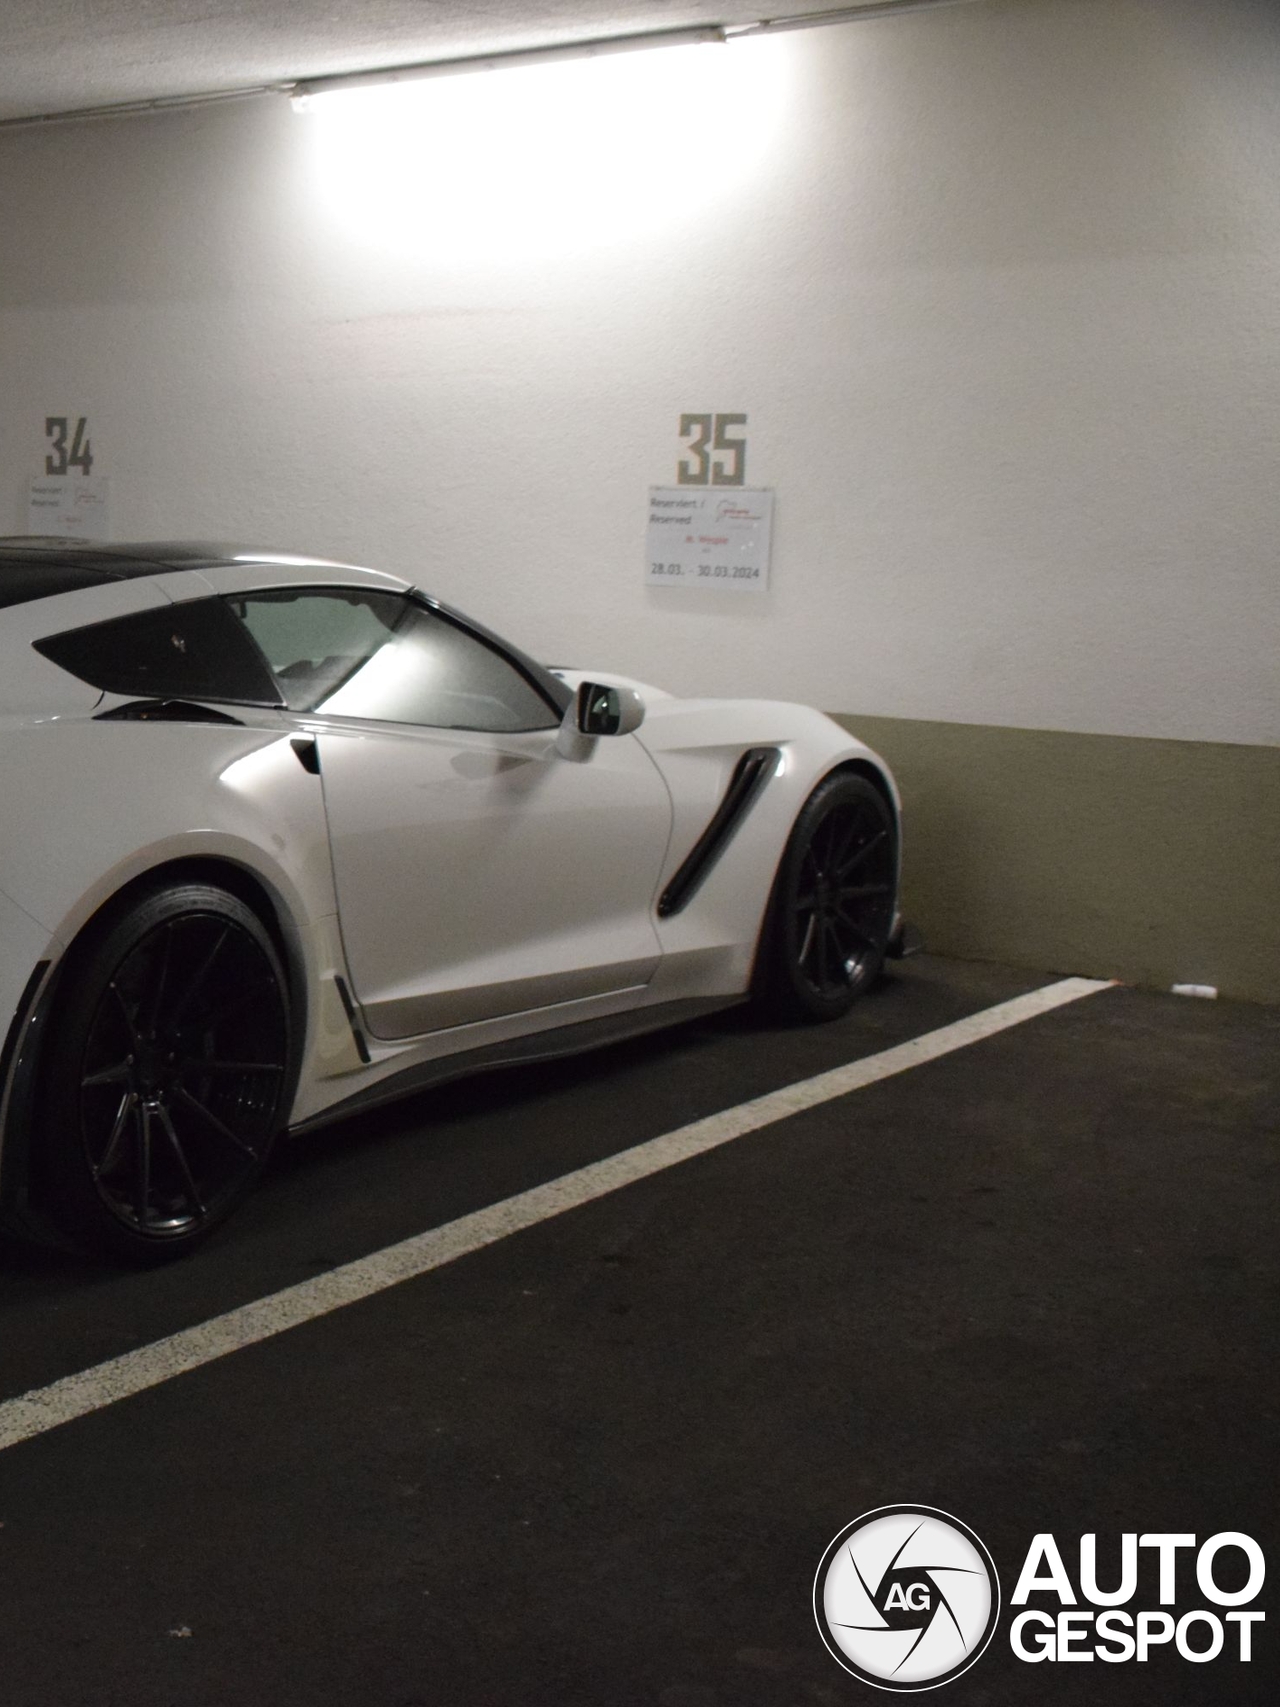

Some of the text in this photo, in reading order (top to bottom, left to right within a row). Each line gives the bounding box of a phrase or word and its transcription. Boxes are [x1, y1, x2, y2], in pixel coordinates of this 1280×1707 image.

[45, 417, 93, 475] 34
[678, 413, 747, 485] 35
[697, 565, 760, 579] 30.03.2024
